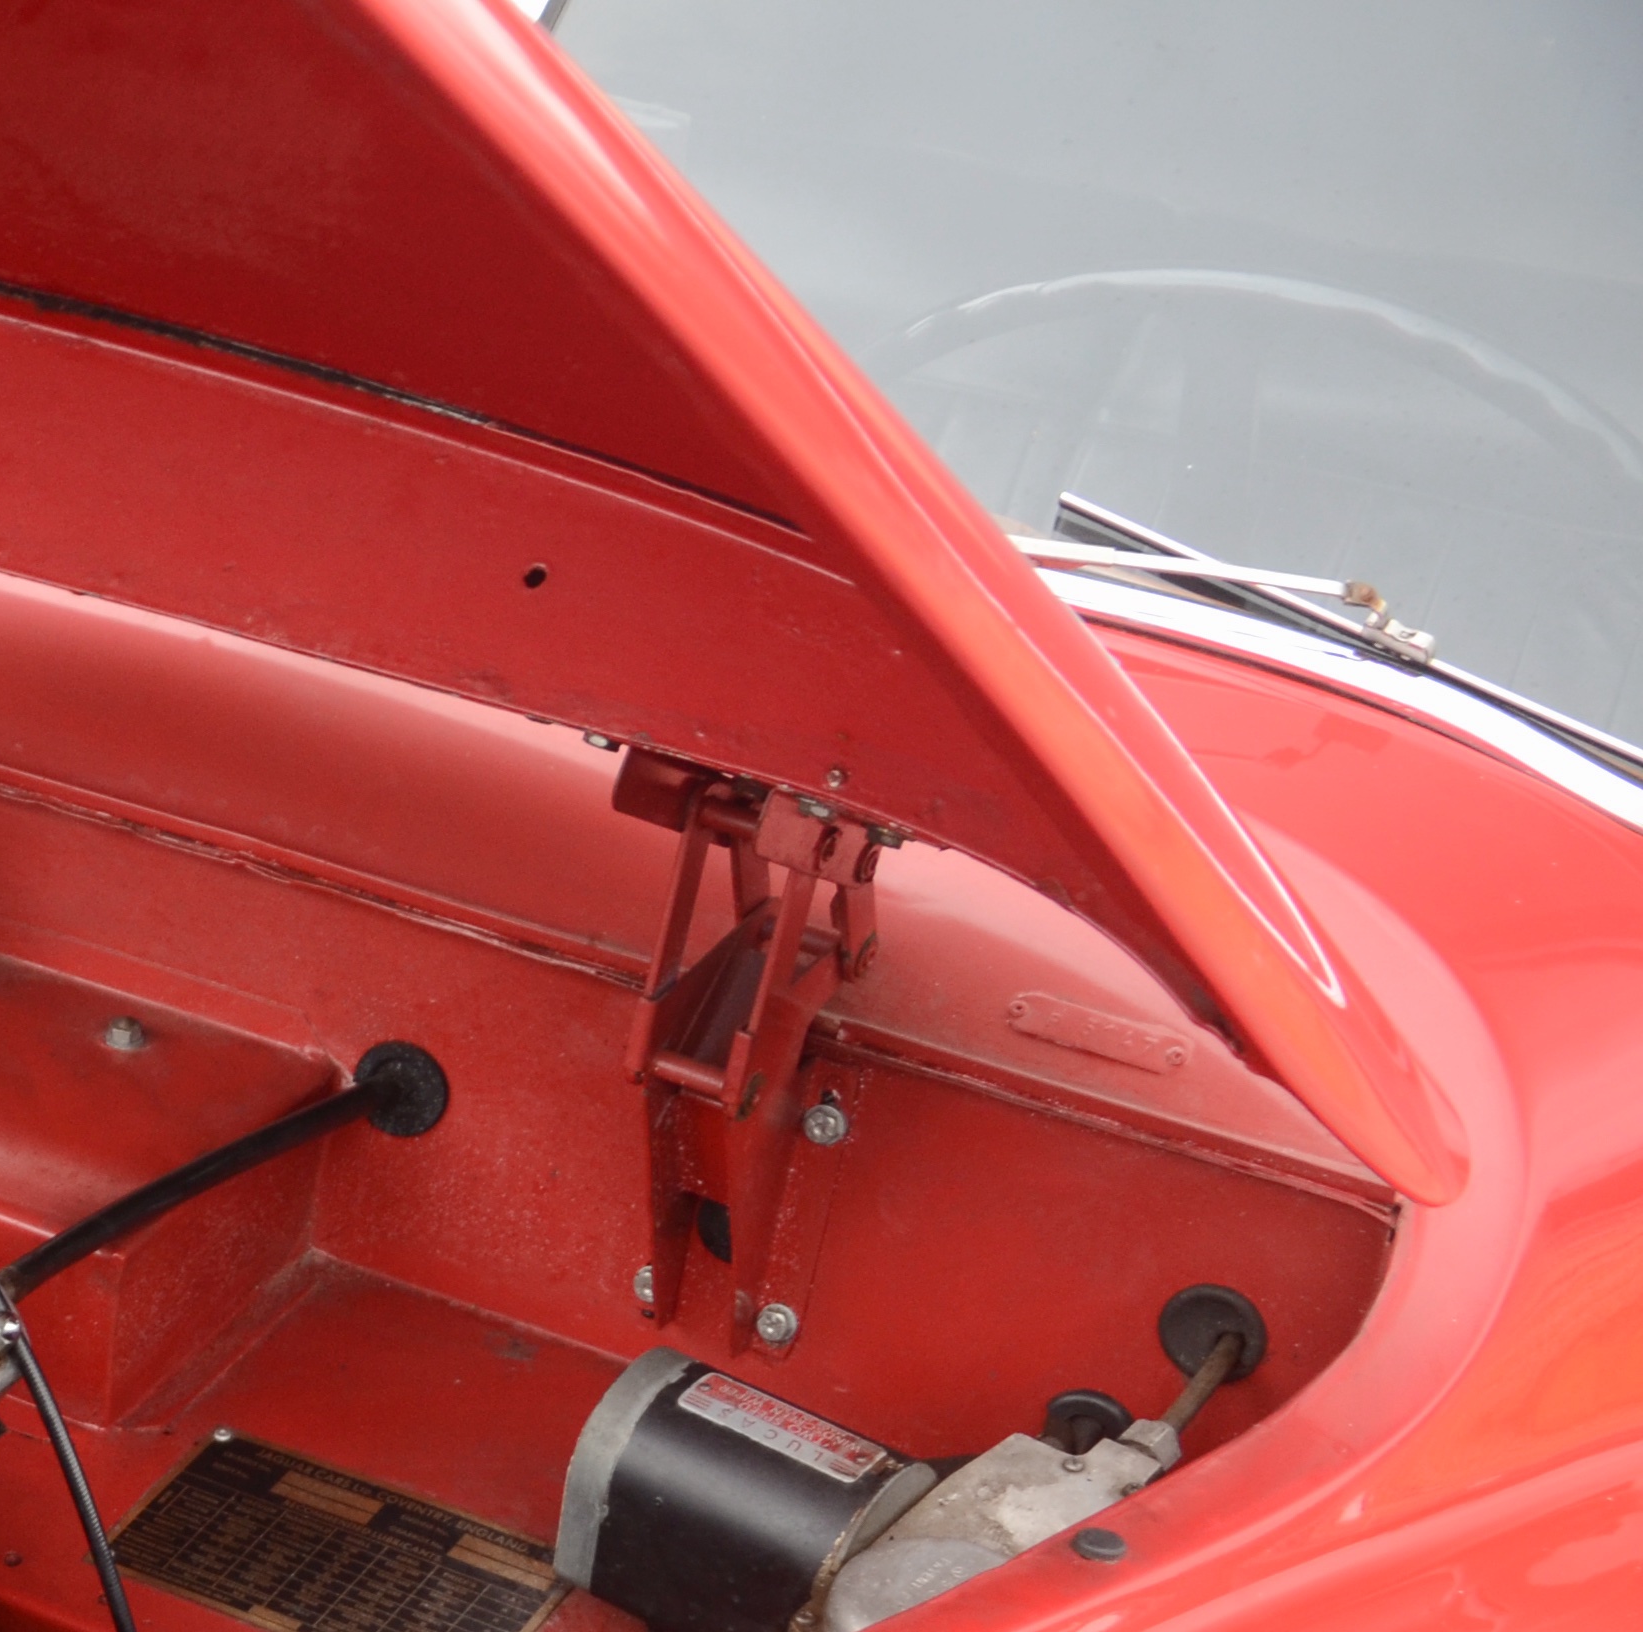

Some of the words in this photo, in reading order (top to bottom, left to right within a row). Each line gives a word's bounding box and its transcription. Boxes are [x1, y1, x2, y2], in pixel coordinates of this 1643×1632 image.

[716, 1382, 766, 1409] WIPER
[734, 1399, 784, 1427] SPEED
[719, 1407, 824, 1462] LUCAS
[767, 1405, 862, 1454] WINDSCREEN
[784, 1421, 824, 1445] TWO
[254, 1448, 316, 1476] JAGUAR
[311, 1469, 354, 1490] CARS
[280, 1497, 373, 1537] RECOMMENDED
[368, 1529, 445, 1564] LUBRICANTS
